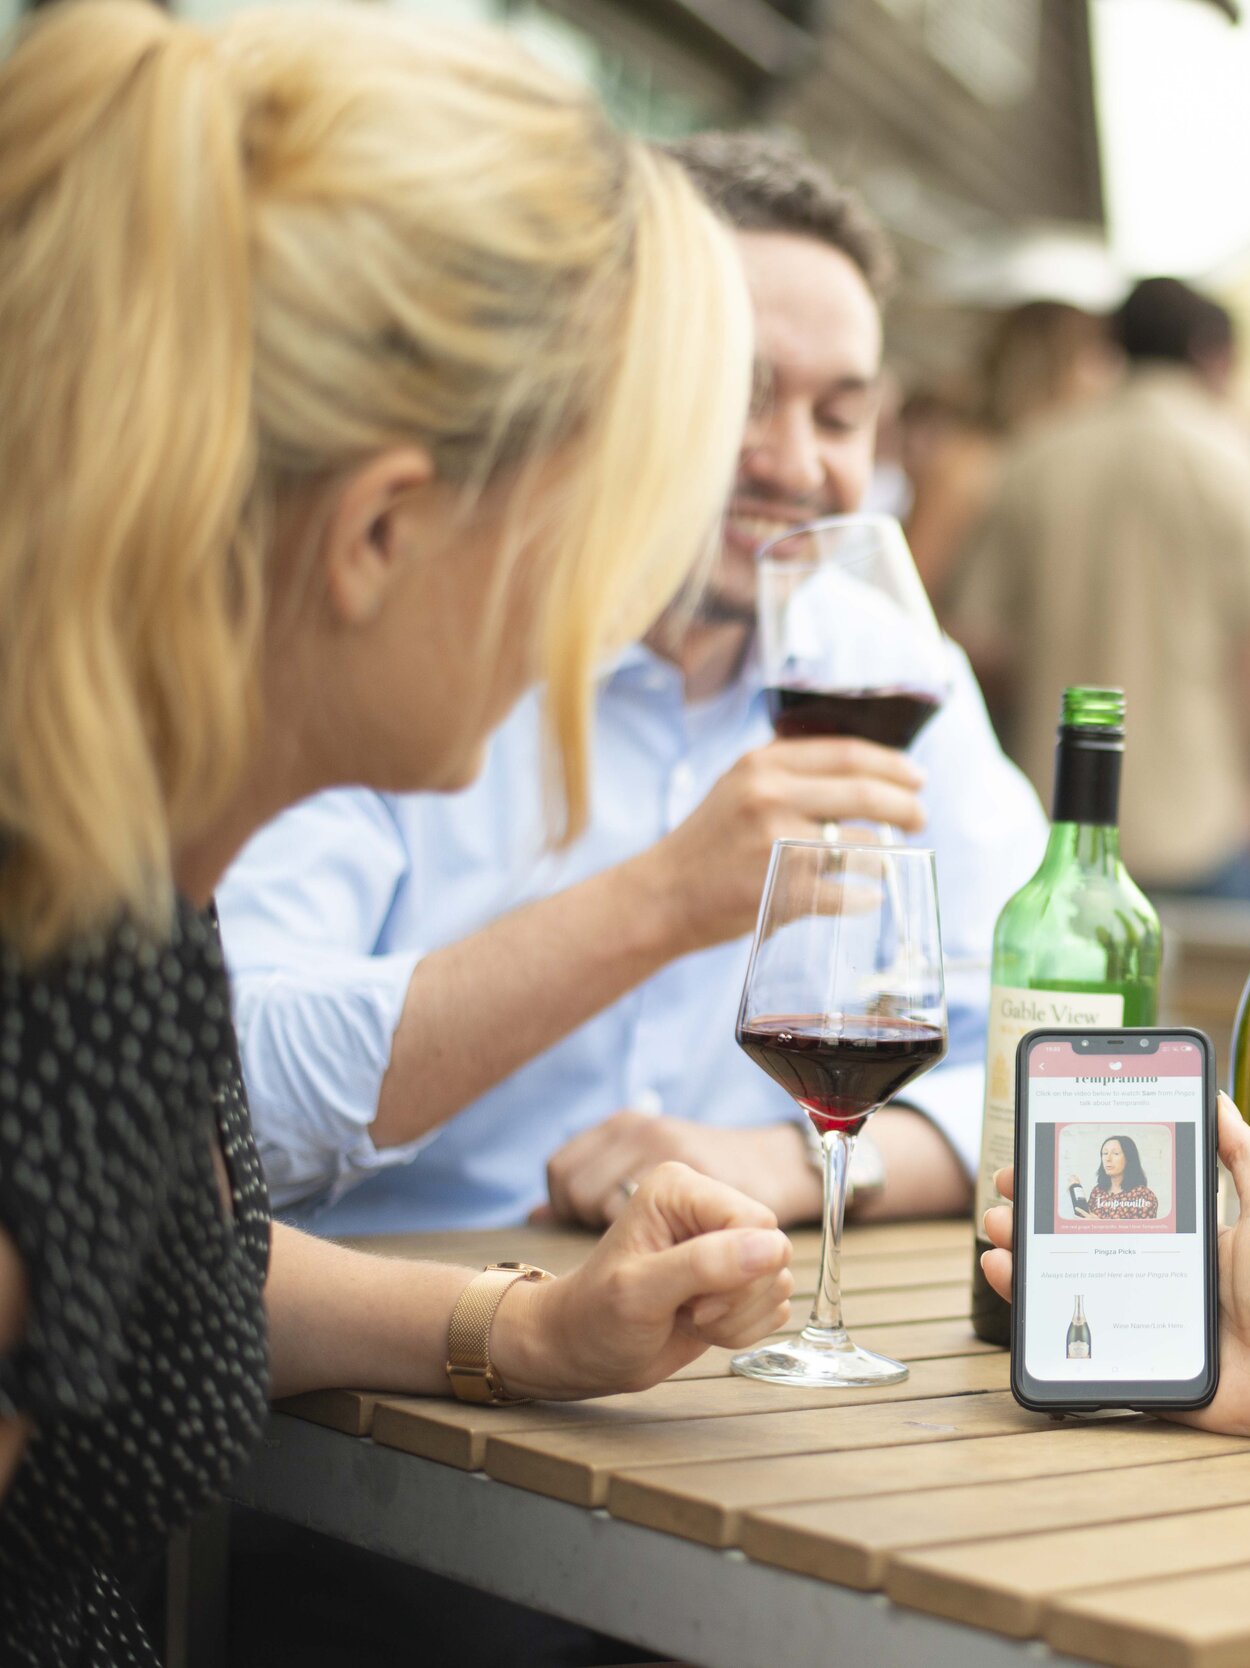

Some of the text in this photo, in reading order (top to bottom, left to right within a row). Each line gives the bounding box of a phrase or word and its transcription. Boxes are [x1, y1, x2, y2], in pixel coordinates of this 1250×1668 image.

[1001, 998, 1099, 1025] Gable View
[1094, 1248, 1117, 1256] Pingza
[1040, 1271, 1064, 1279] Always
